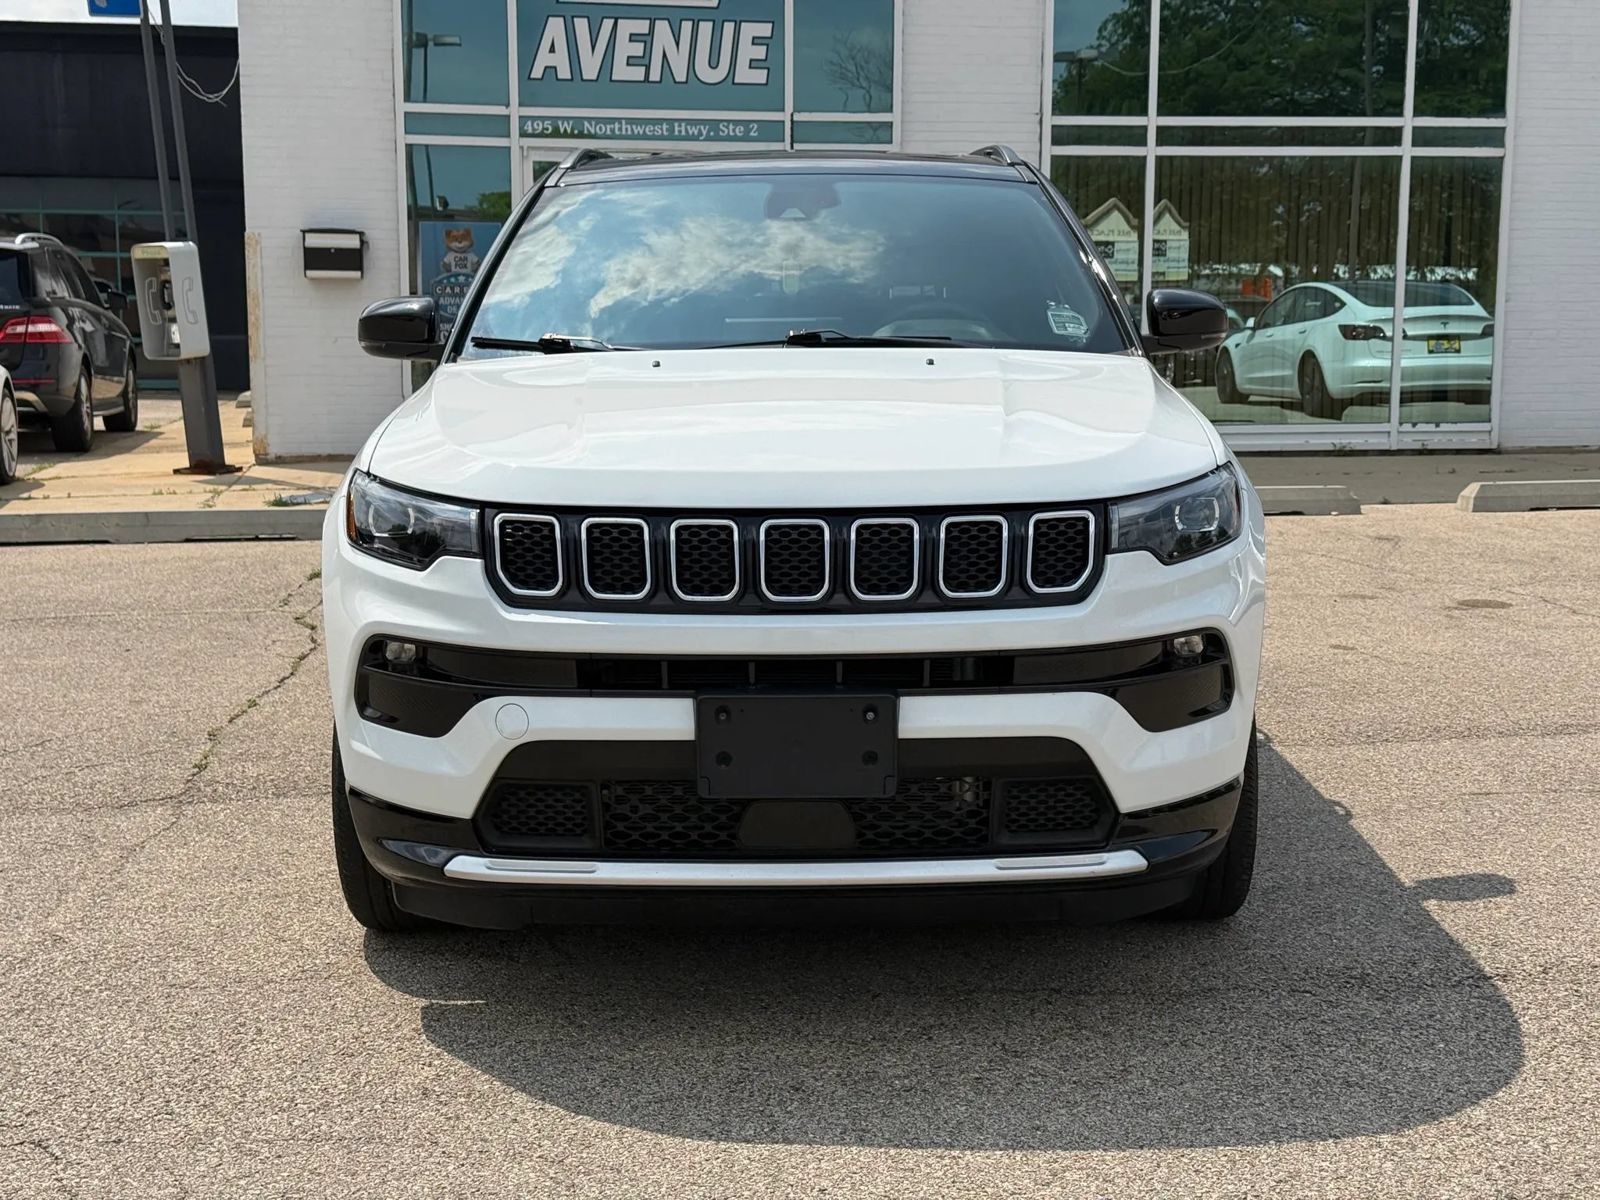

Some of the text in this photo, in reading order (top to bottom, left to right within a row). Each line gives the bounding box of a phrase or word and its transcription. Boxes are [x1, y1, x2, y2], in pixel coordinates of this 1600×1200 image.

[528, 15, 774, 86] AVENUE
[523, 119, 759, 140] 495 W. Northwest Hwy. Ste 2
